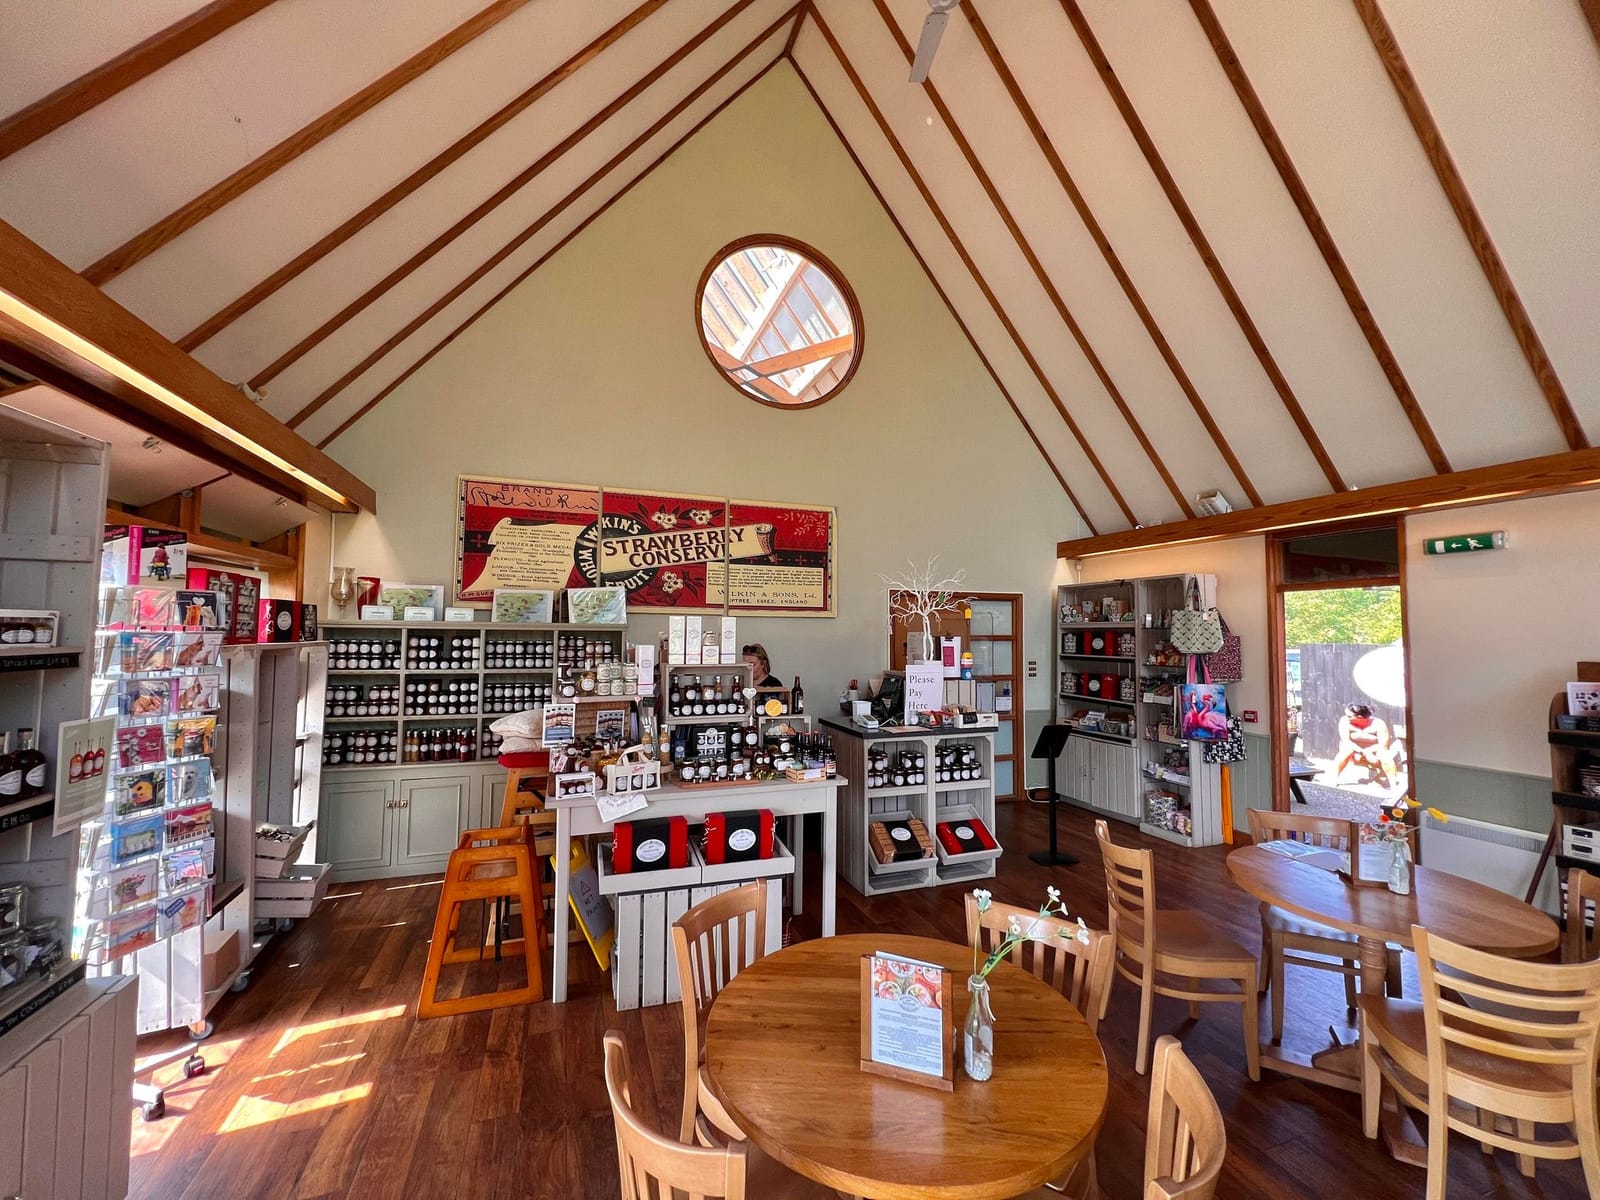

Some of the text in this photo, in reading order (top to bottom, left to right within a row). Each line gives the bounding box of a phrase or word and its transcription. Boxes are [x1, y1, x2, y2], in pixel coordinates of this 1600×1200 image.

[501, 484, 553, 495] BRAND
[584, 516, 641, 541] WKIN'S
[602, 527, 744, 557] STRAWBERRY
[578, 548, 599, 585] WHO
[717, 589, 756, 598] WLKIN
[909, 674, 935, 684] Please
[909, 688, 922, 699] Pay
[908, 701, 928, 710] Here
